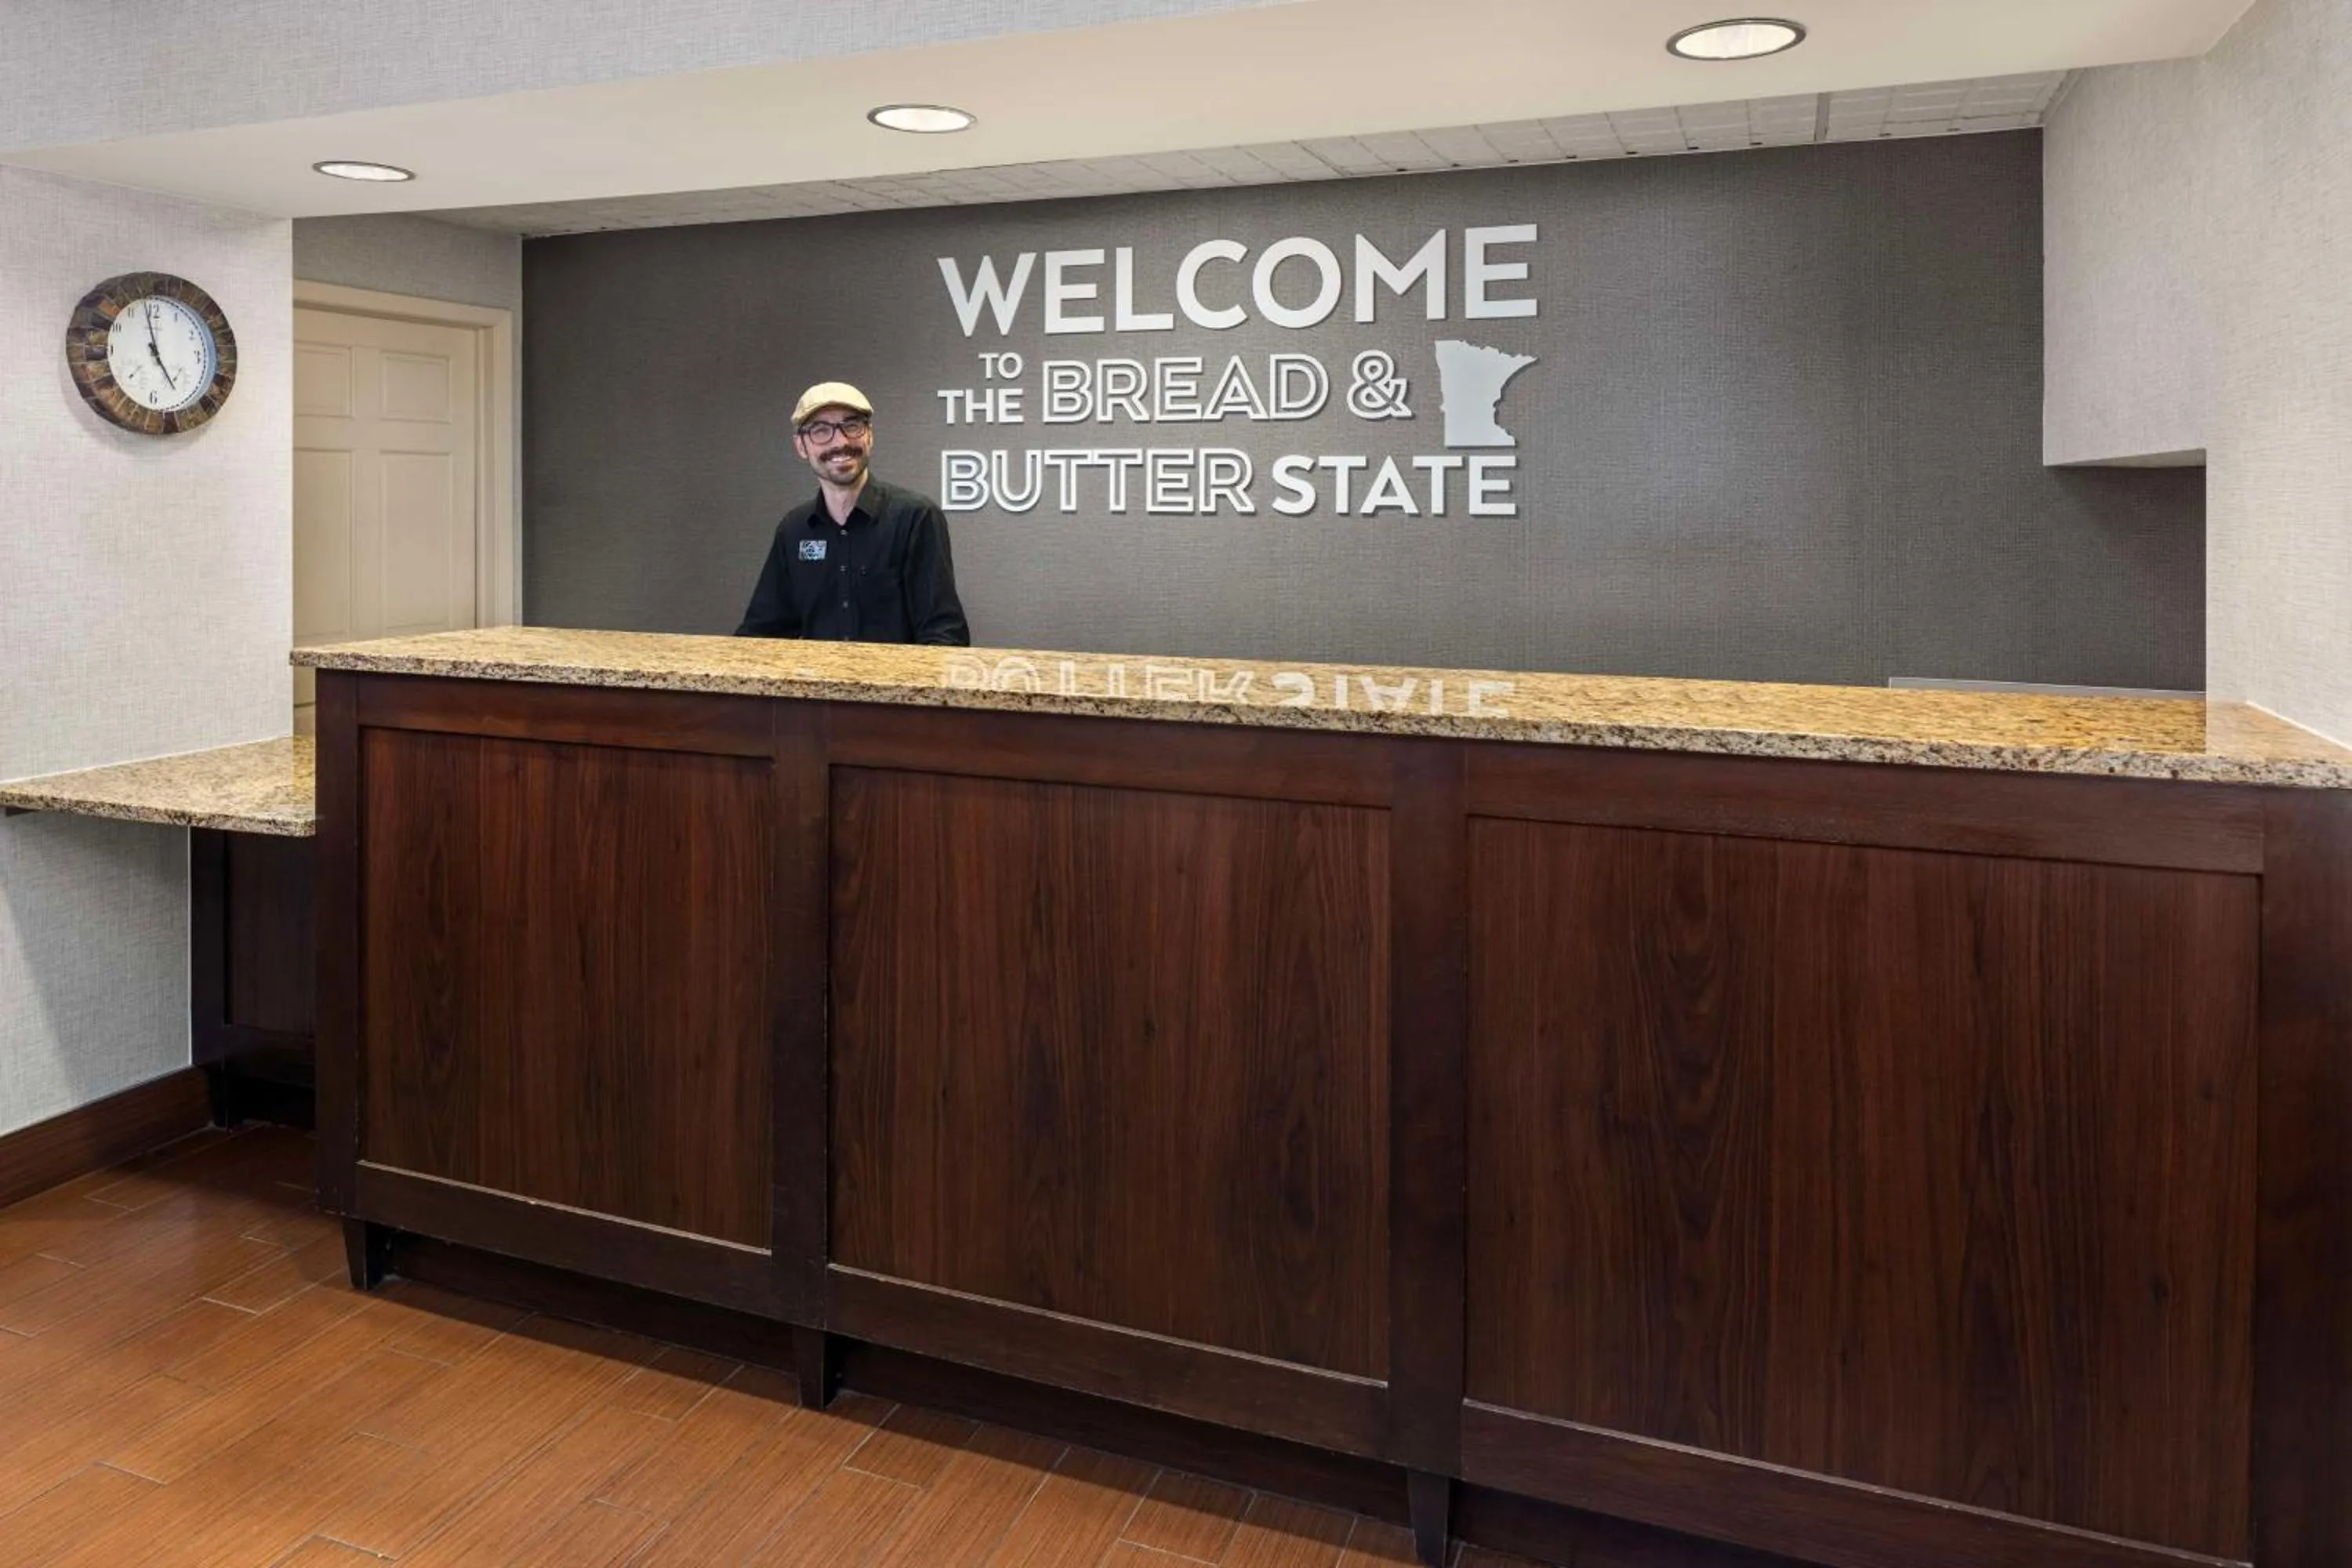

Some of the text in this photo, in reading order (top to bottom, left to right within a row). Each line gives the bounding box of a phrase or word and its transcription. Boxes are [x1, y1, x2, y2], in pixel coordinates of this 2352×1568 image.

[937, 223, 1538, 337] WELCOME
[937, 350, 1412, 423] THE BREAD &
[978, 352, 1023, 379] TO
[941, 448, 1517, 515] BUTTER STATE
